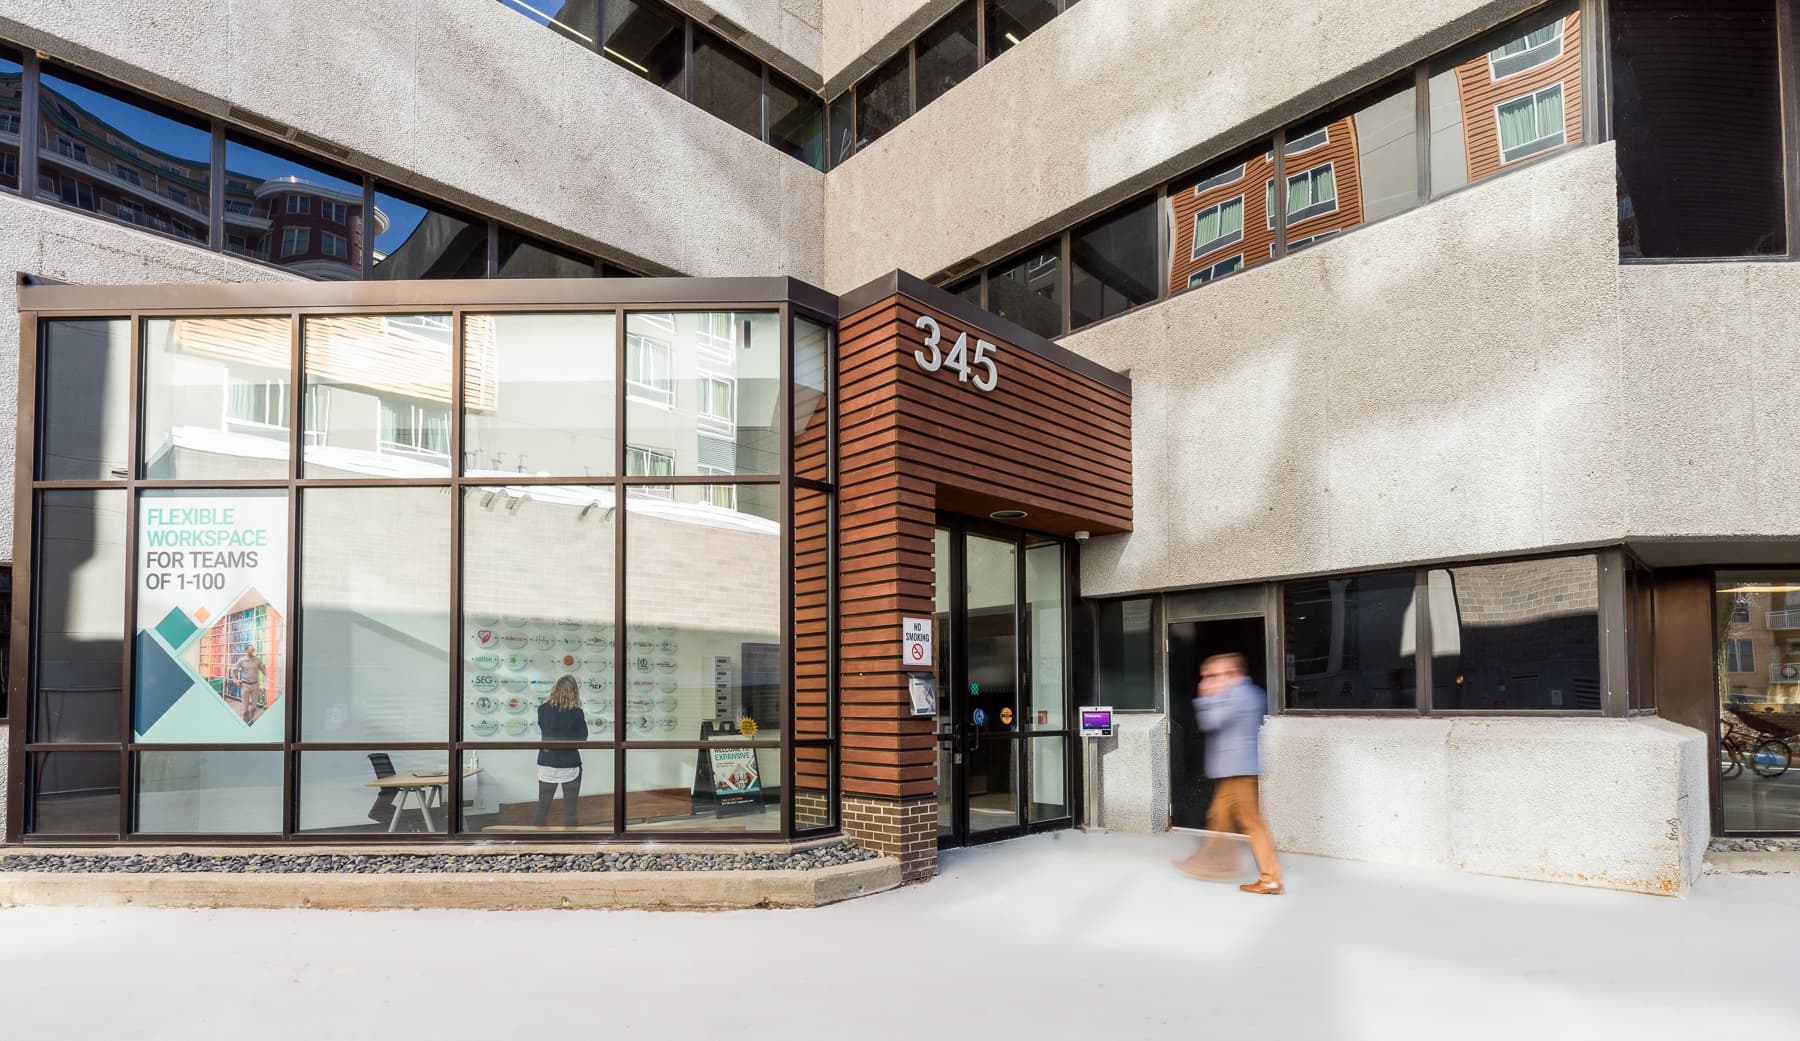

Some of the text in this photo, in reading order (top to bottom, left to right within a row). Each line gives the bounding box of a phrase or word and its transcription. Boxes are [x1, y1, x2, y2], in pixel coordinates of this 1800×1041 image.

[914, 316, 998, 391] 345
[148, 508, 234, 525] FLEXIBLE
[147, 530, 267, 547] WORKSPACE
[147, 551, 258, 568] FOR TEAMS
[146, 573, 225, 590] OF 1-100
[914, 623, 922, 631] NO
[906, 632, 929, 642] SMOKING
[476, 675, 493, 684] SEG
[715, 752, 750, 760] EXPANSIVE
